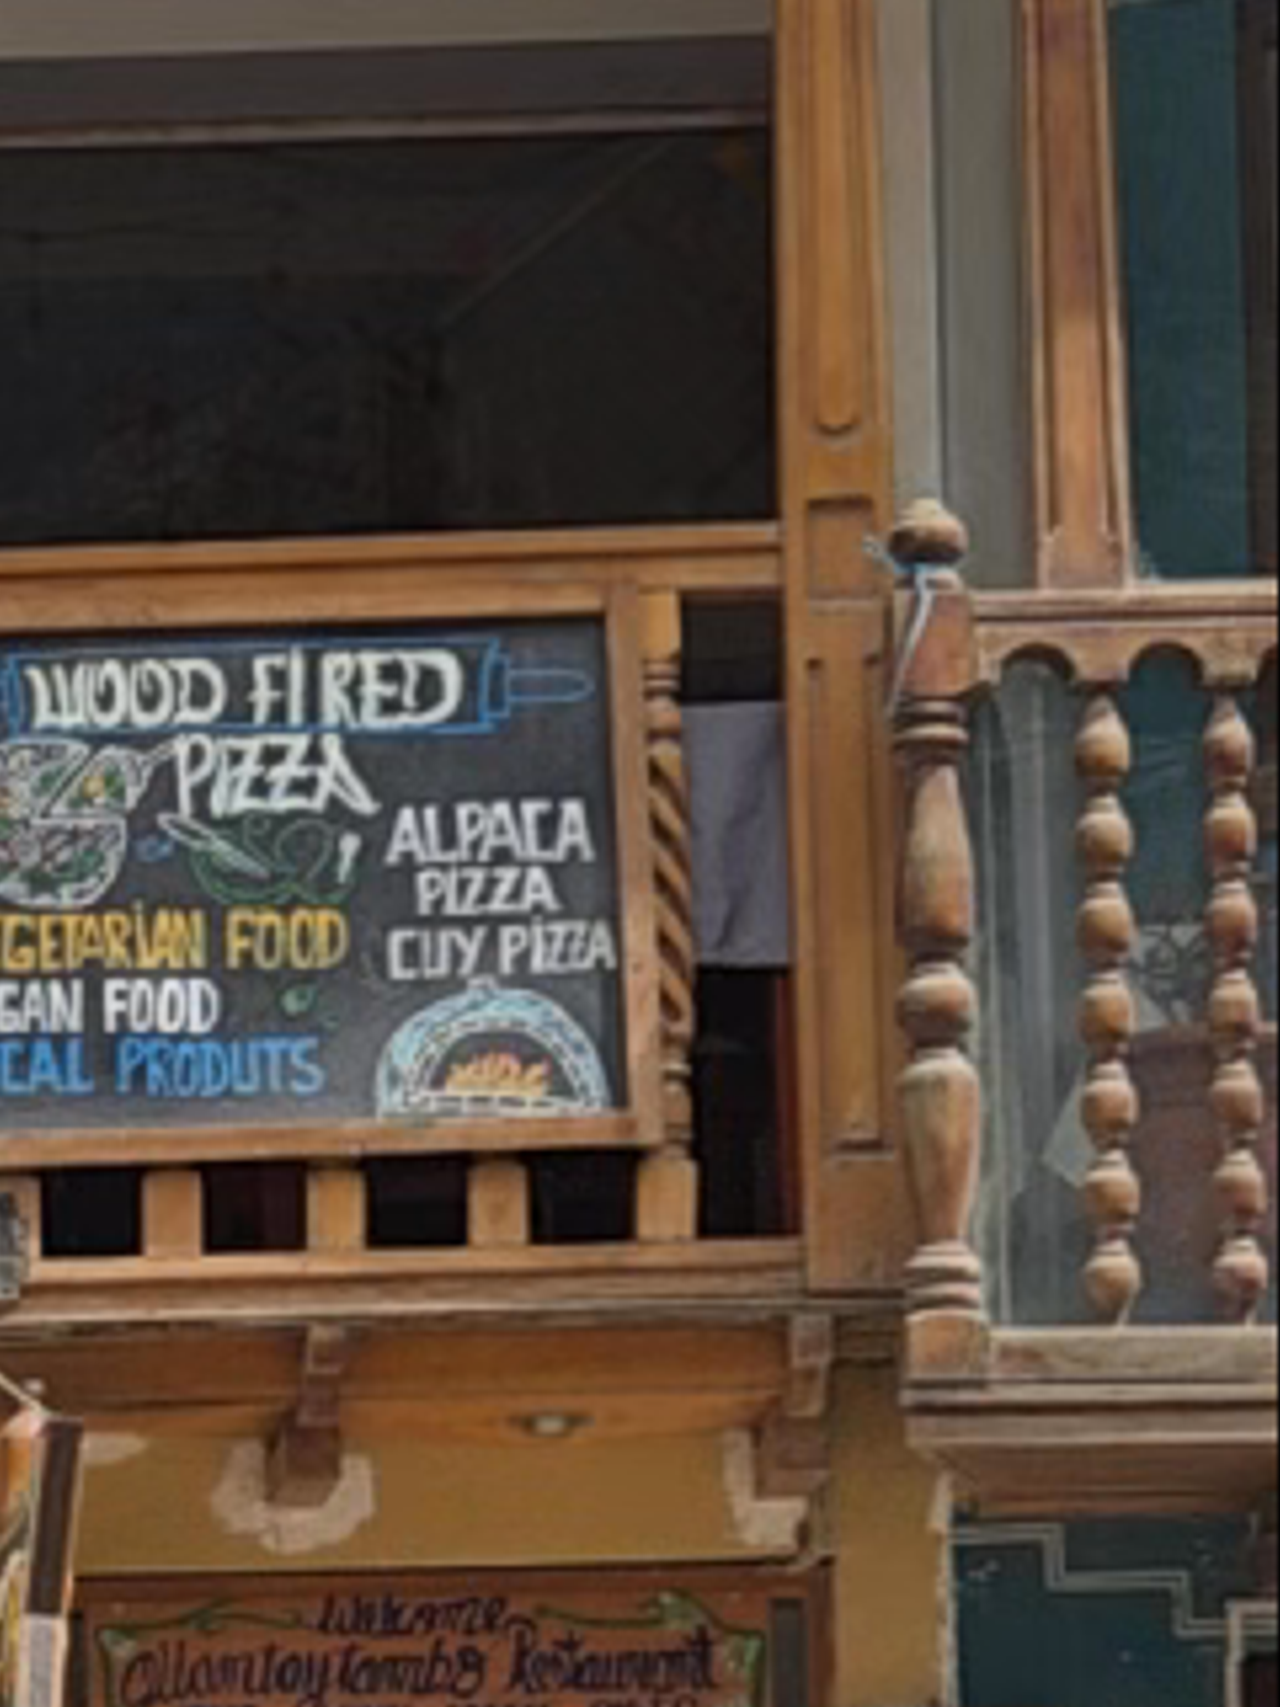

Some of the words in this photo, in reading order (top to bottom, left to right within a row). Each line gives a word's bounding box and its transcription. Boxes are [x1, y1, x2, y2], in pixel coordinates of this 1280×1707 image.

[27, 655, 226, 732] WOOD
[173, 731, 382, 817] PIZZA
[386, 798, 596, 866] ALPACA
[416, 866, 559, 918] PIZZA
[225, 907, 350, 971] FOOD
[388, 926, 488, 981] CUY
[500, 915, 618, 974] PIZZA
[104, 979, 222, 1035] FOOD
[116, 1035, 325, 1096] PRODUTS
